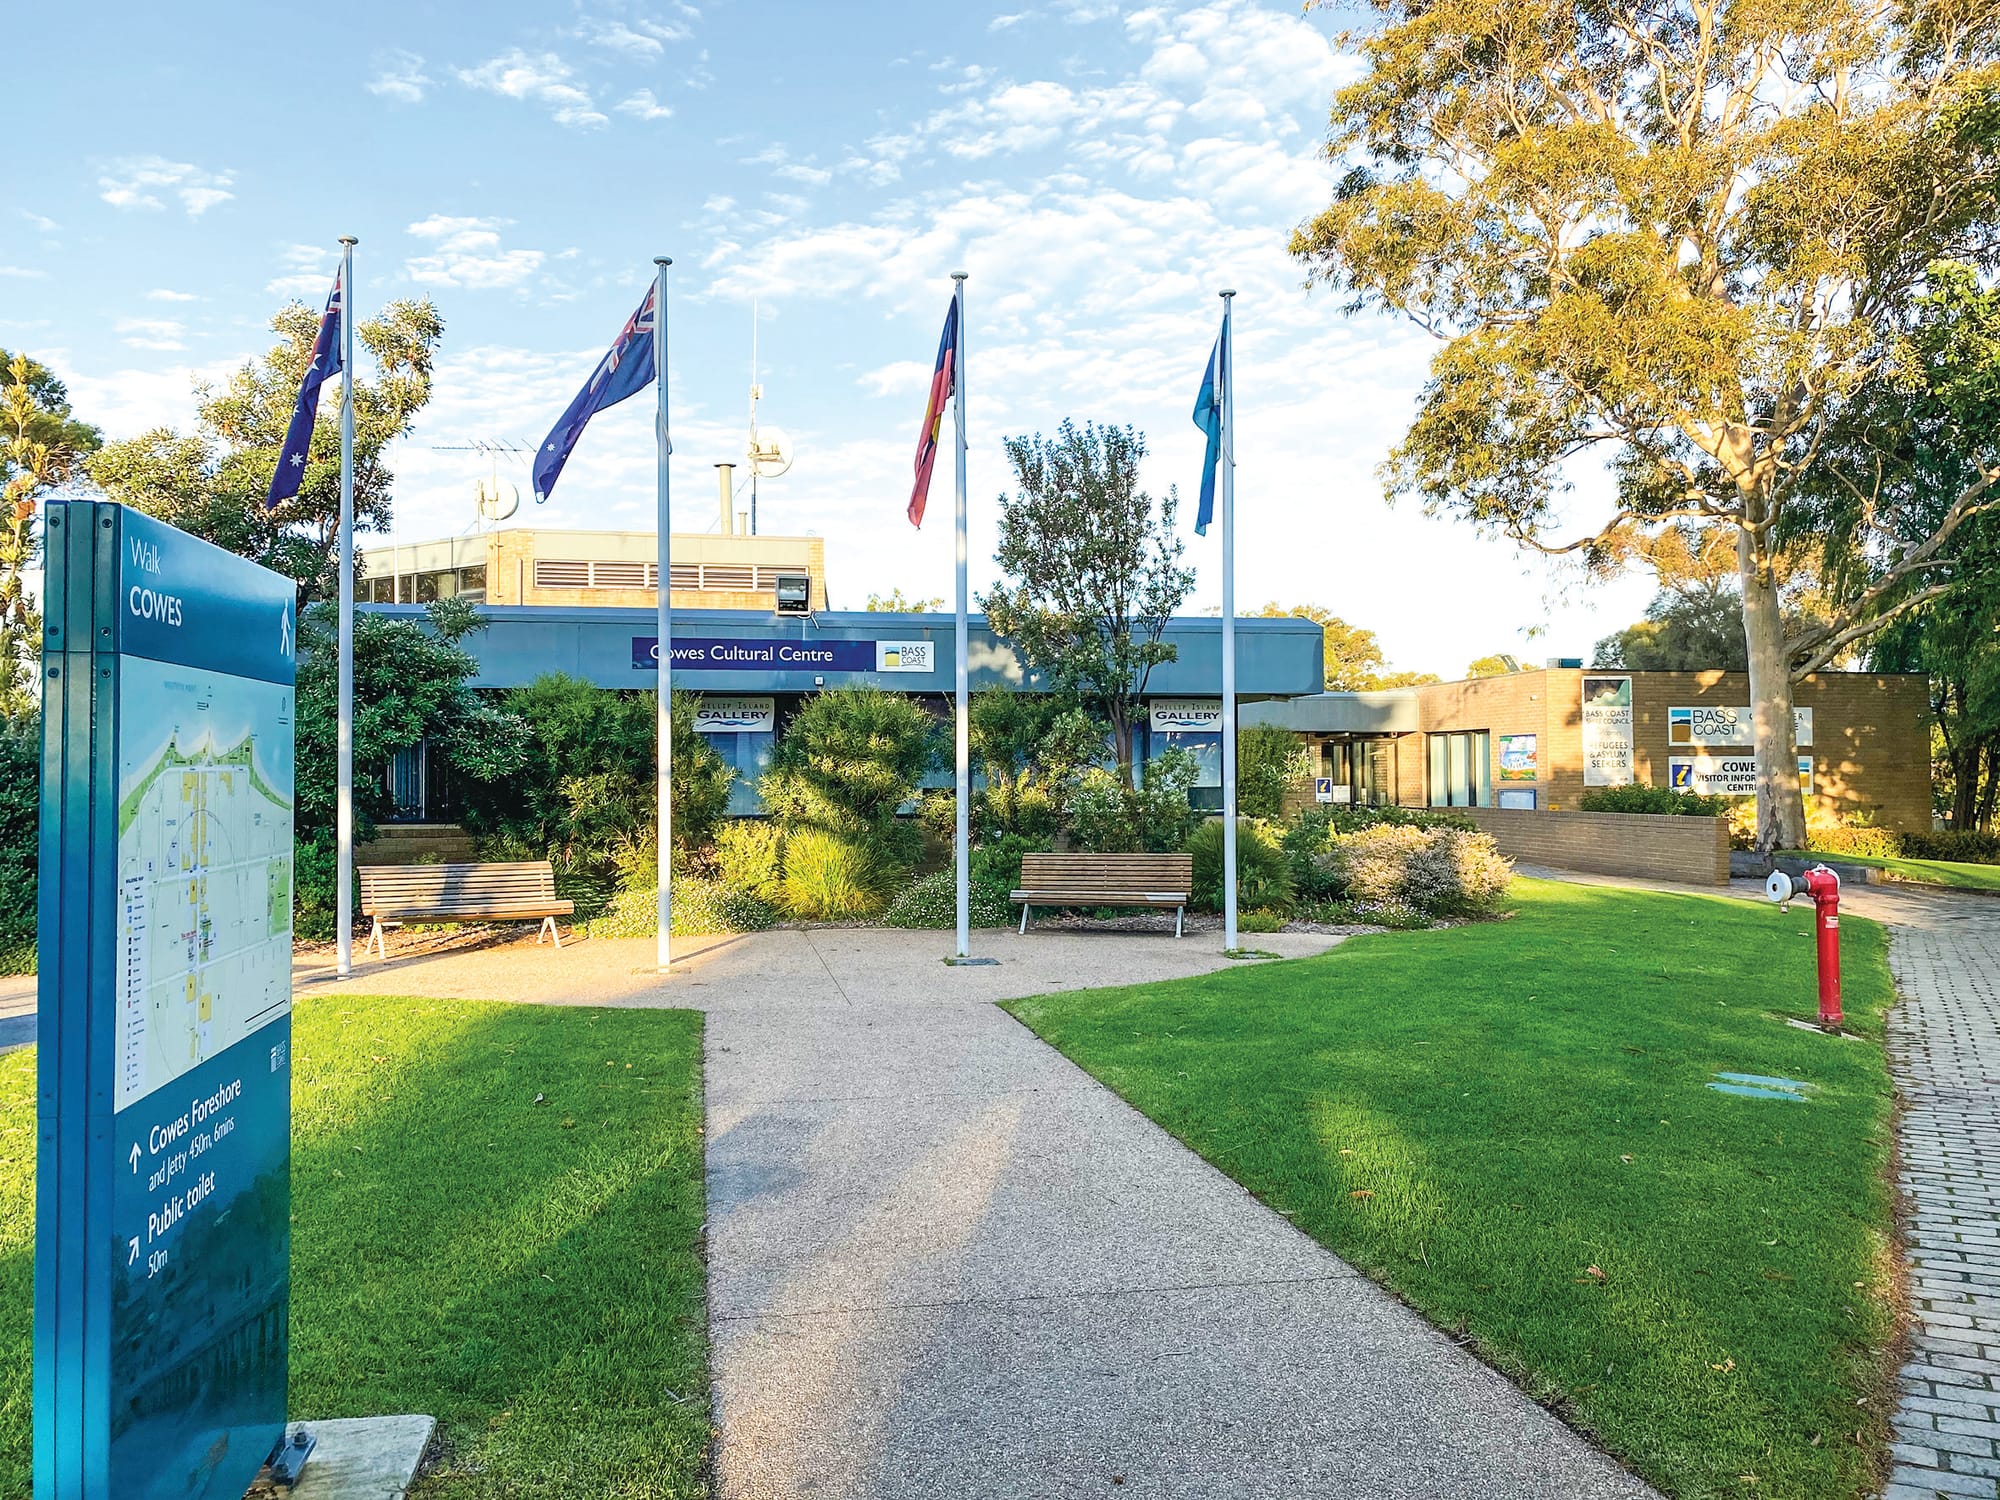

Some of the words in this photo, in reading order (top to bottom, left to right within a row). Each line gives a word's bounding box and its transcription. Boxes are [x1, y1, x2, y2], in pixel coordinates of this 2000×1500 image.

[130, 535, 161, 575] Walk
[129, 585, 183, 628] COWES
[710, 645, 773, 660] Cultural
[779, 646, 833, 662] Centre
[901, 646, 926, 657] BASS
[901, 656, 926, 664] COAST
[697, 710, 769, 719] GALLERY
[1155, 711, 1220, 720] GALLERY
[1692, 709, 1737, 724] BASS
[1693, 724, 1737, 736] COAST
[1589, 741, 1629, 750] EFUGEES
[1596, 750, 1627, 758] ASYLUM
[1591, 759, 1627, 768] SEEKERS
[1722, 762, 1756, 772] COWE
[1697, 774, 1729, 782] VISITOR
[1731, 774, 1756, 782] INFOR
[1727, 783, 1757, 792] CENTR
[149, 1113, 189, 1154] Cowes
[191, 1078, 241, 1128] Foreshore
[149, 1163, 165, 1192] and
[166, 1148, 187, 1185] Jetty
[189, 1132, 213, 1160] 450m,
[214, 1116, 234, 1143] 6mins
[148, 1195, 184, 1244] Public
[187, 1169, 215, 1211] toilet
[148, 1249, 168, 1279] 50m
